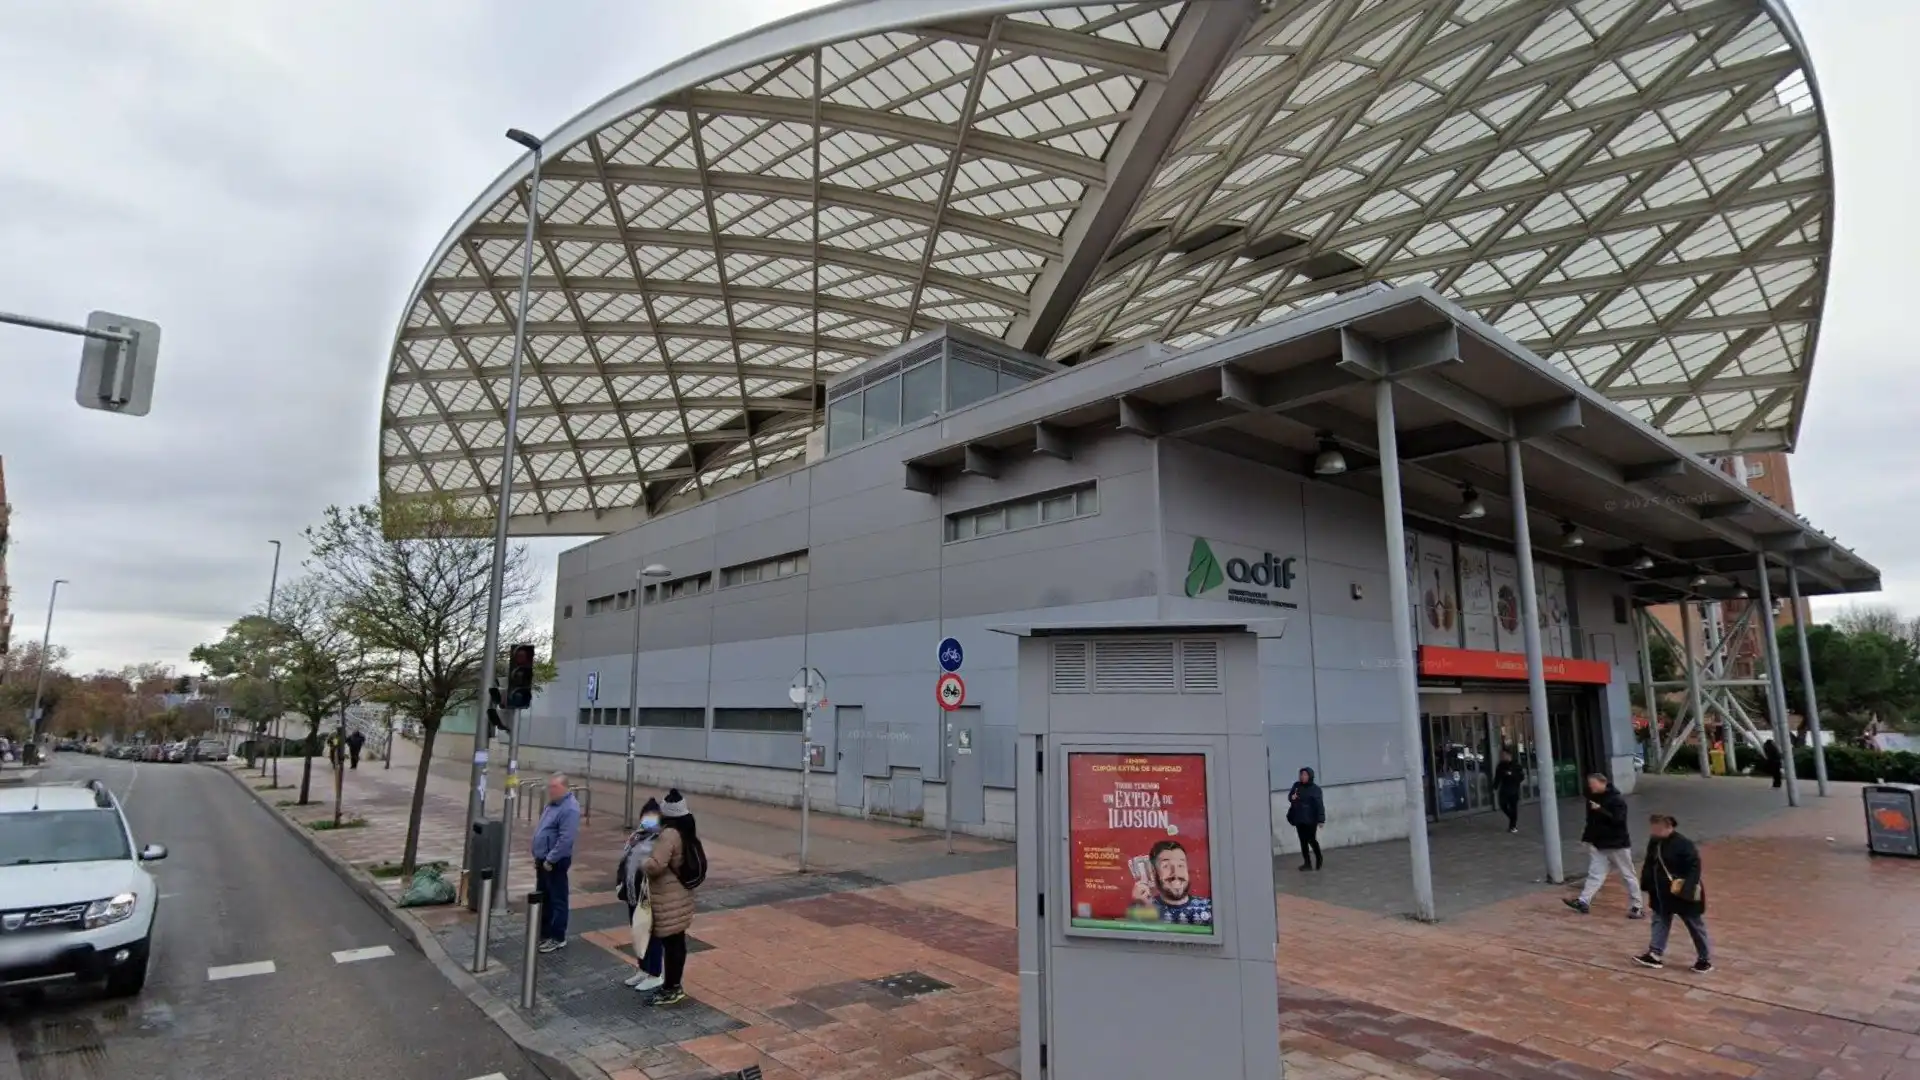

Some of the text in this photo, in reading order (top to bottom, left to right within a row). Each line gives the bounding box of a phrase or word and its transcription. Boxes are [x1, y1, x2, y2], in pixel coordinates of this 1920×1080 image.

[1226, 552, 1296, 589] adif
[1151, 765, 1182, 773] NAVIDAD
[1115, 790, 1161, 808] EXTRA
